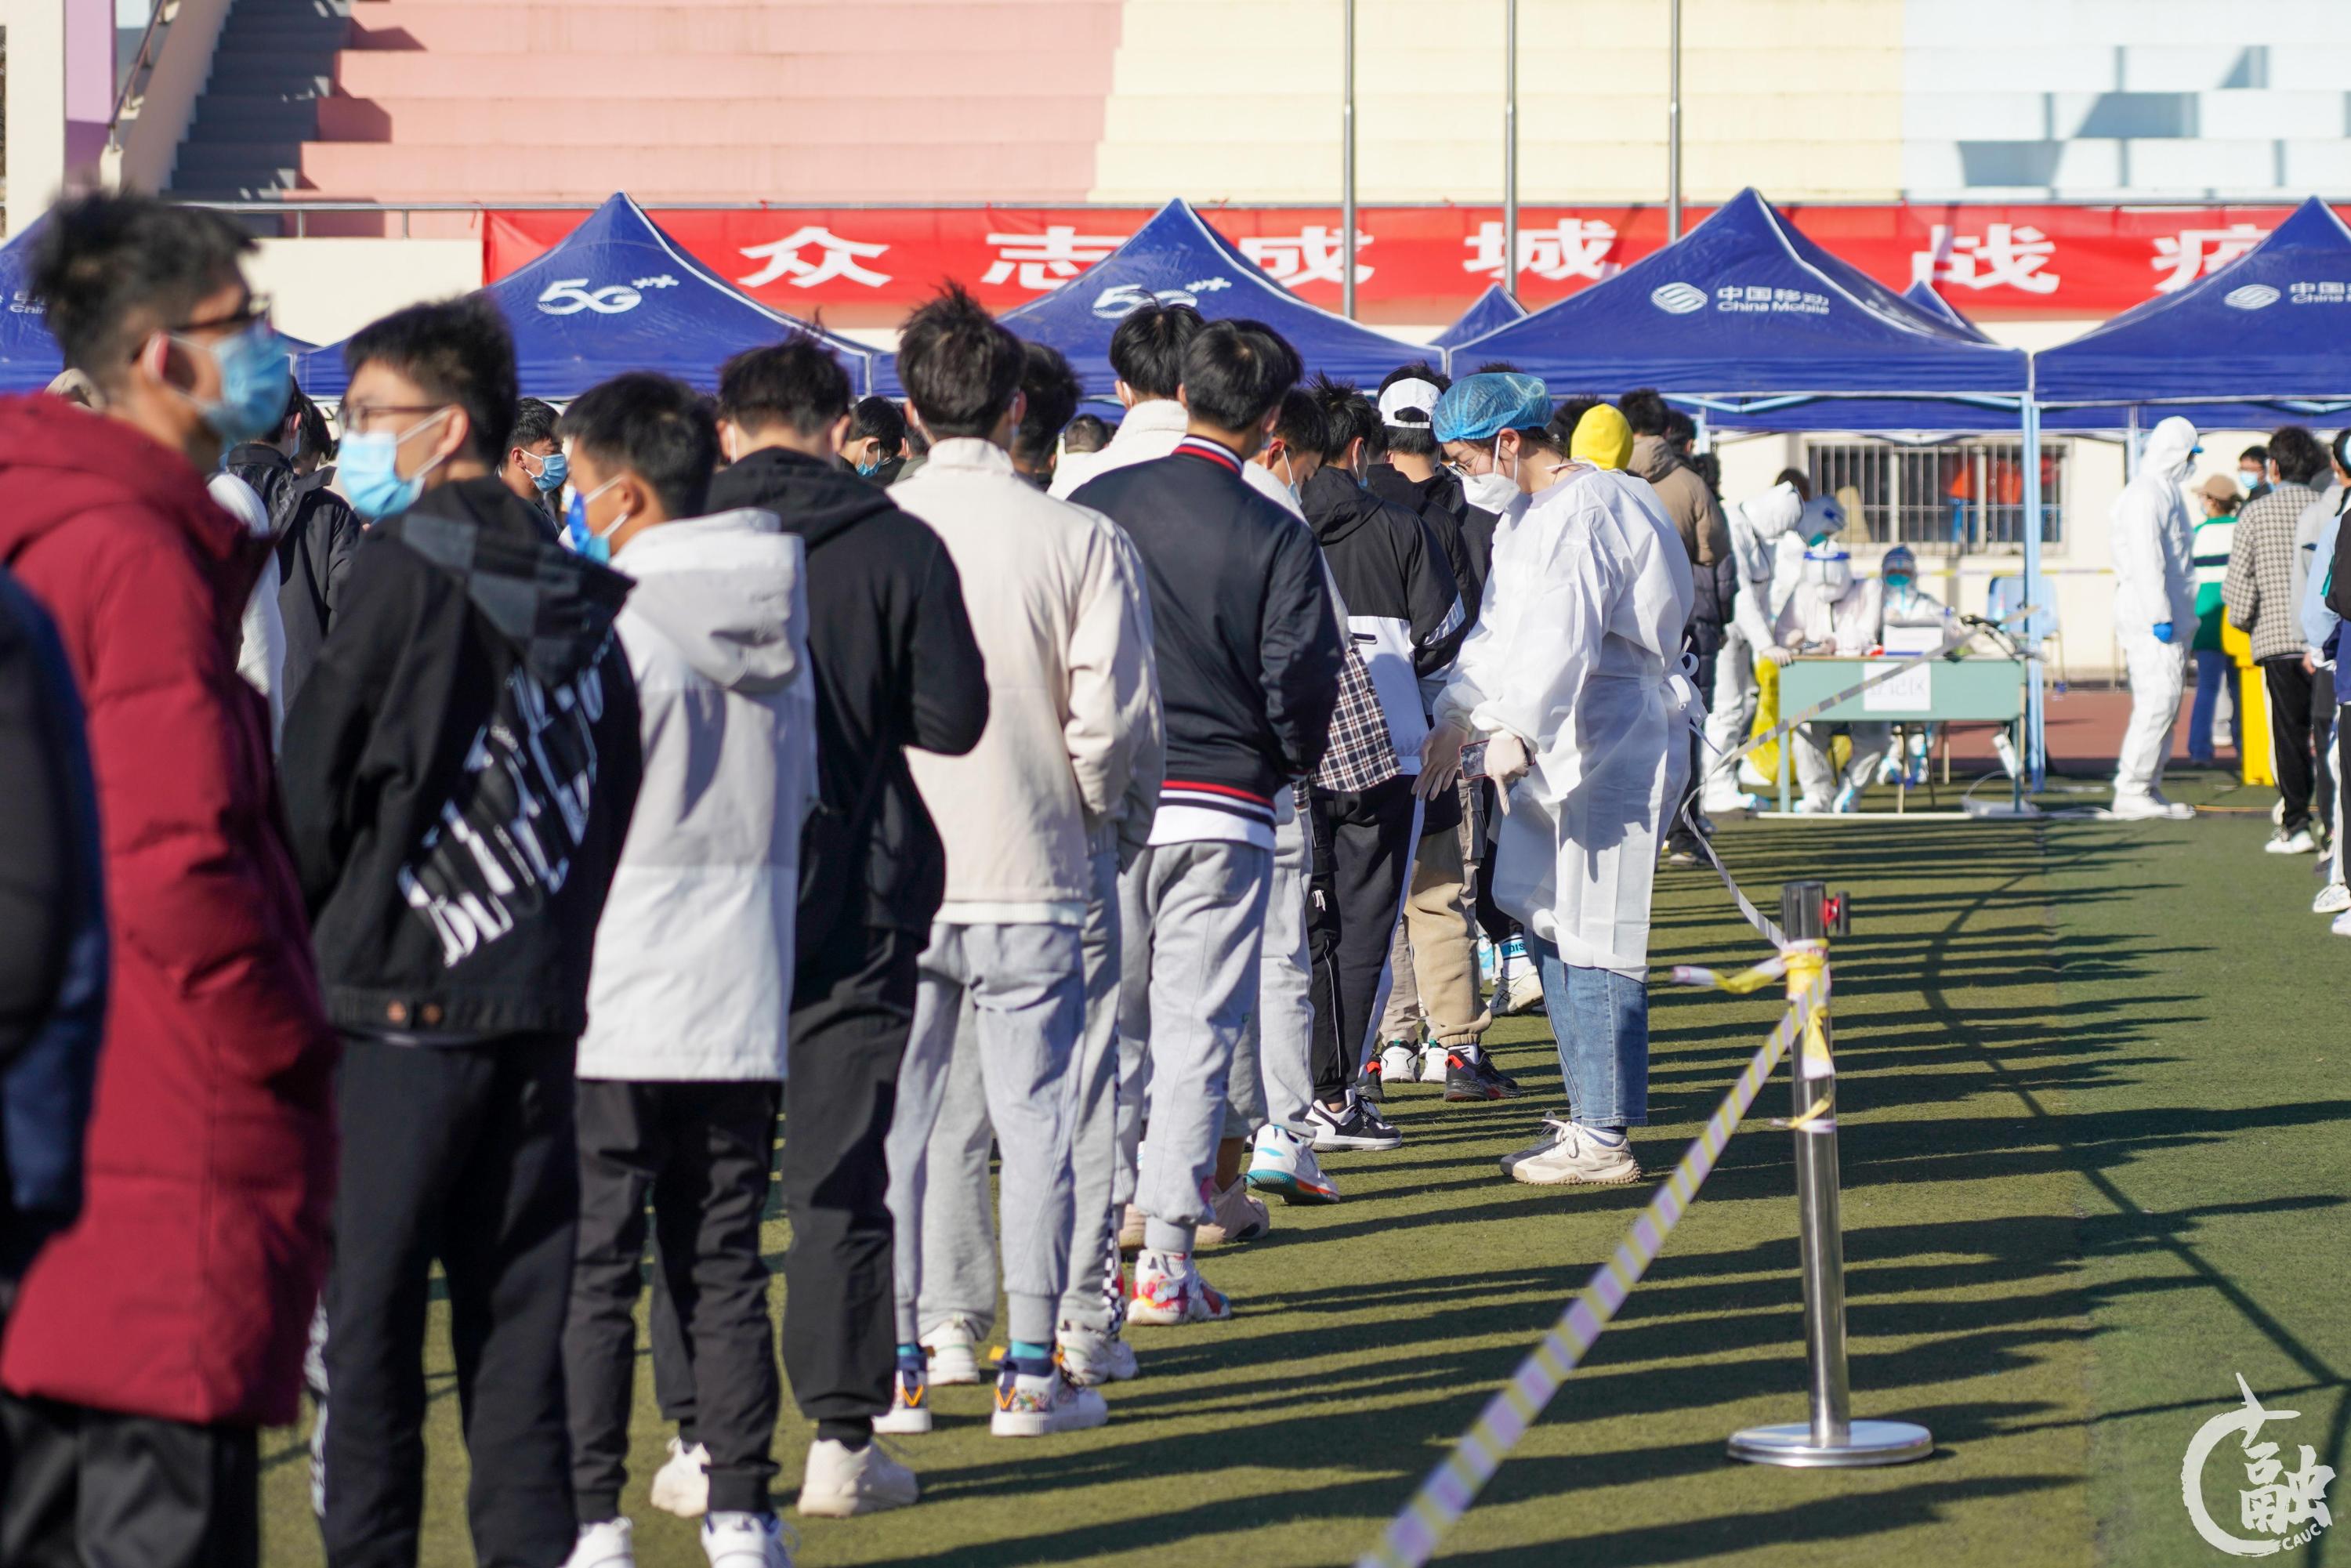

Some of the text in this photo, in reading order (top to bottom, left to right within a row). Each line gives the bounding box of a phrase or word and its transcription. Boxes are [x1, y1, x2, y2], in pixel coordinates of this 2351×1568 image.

[2289, 281, 2351, 295] 中国
[1717, 285, 1830, 306] 中国移动
[1717, 301, 1830, 315] China Mobile
